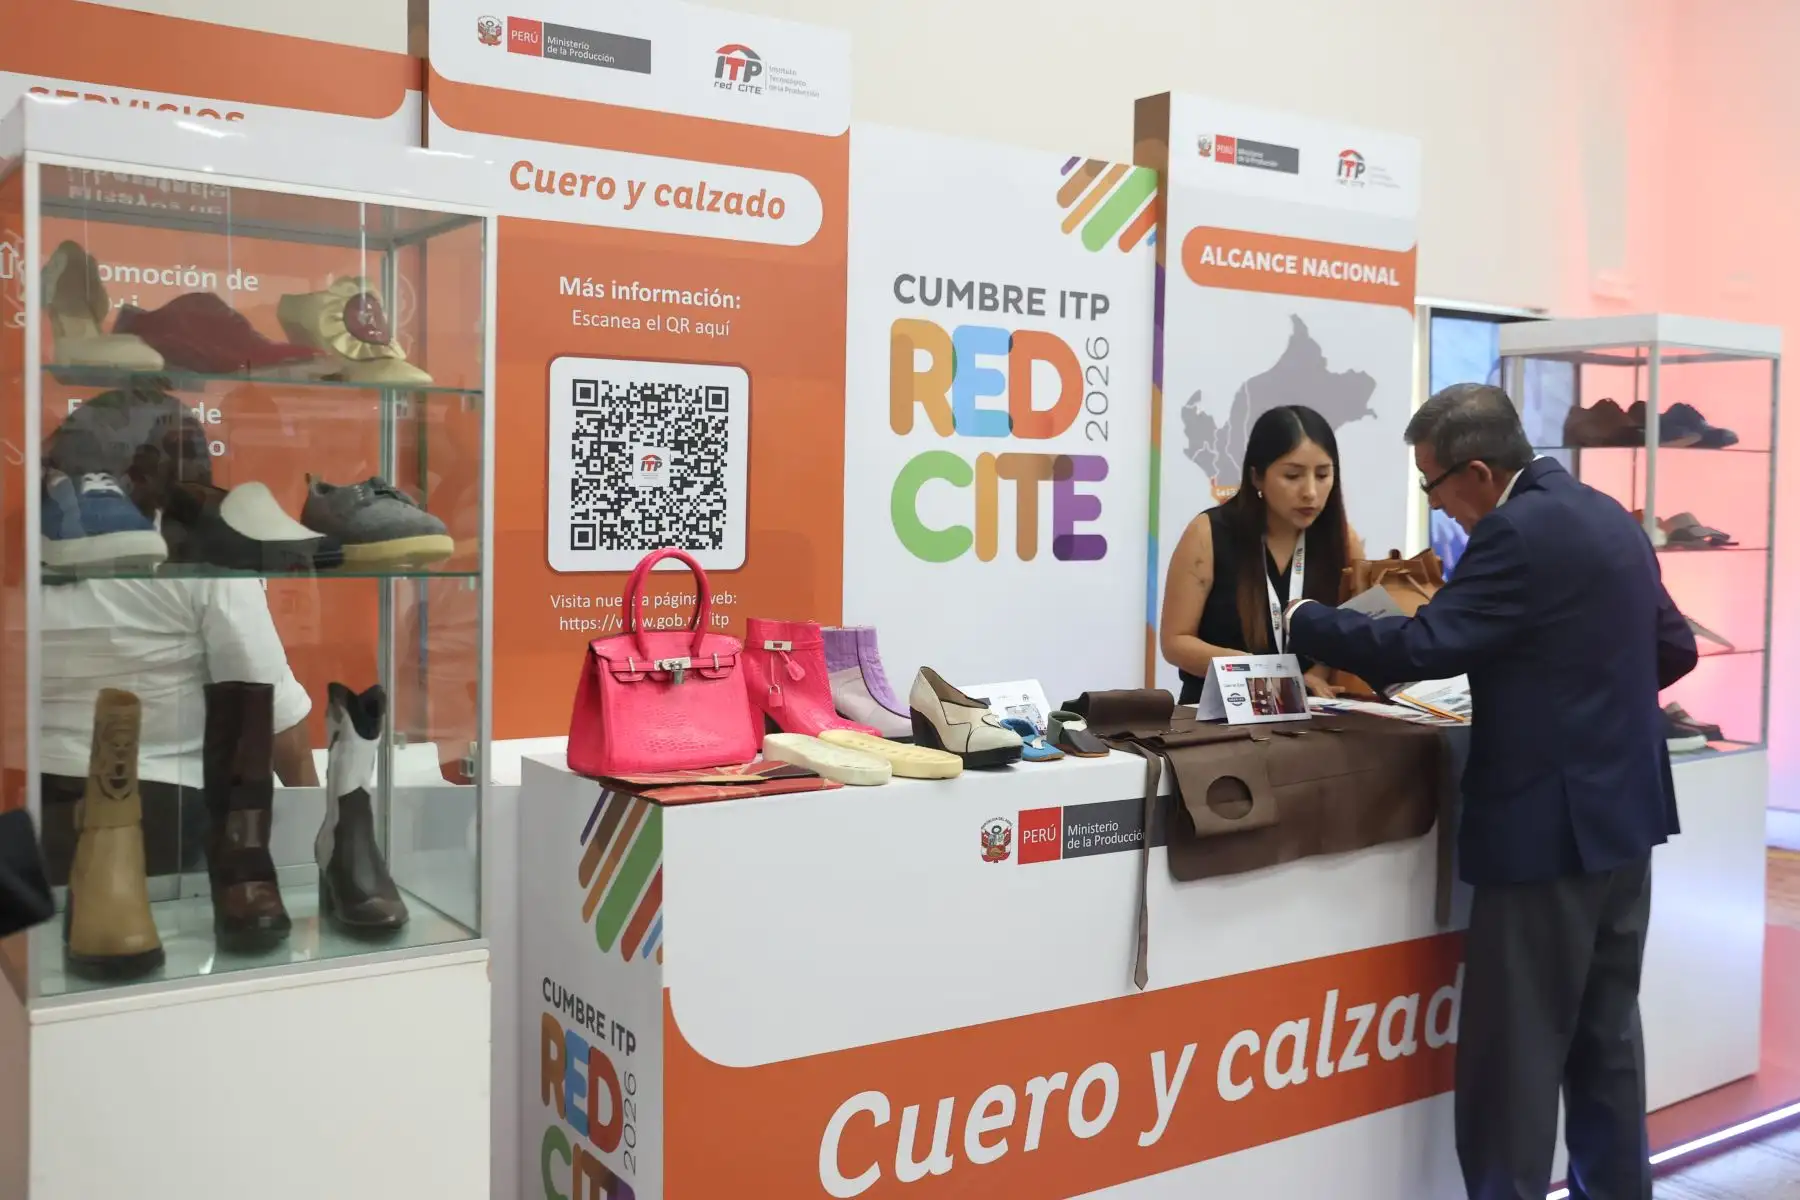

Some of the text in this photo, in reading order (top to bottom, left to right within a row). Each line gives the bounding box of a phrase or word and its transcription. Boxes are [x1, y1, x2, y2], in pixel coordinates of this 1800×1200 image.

[511, 29, 539, 44] PERÚ
[547, 36, 590, 51] Ministerio
[547, 45, 615, 64] de la Producción
[715, 55, 762, 83] ITP
[714, 80, 762, 95] red CITE
[1338, 159, 1365, 179] ITP
[509, 160, 785, 220] Cuero y calzado
[98, 264, 259, 291] omoción de
[1200, 245, 1400, 286] ALCANCE NACIONAL
[559, 275, 741, 309] Más información:
[893, 273, 1110, 321] CUMBRE ITP
[572, 309, 730, 338] Escanea el QR aquí
[889, 317, 1084, 440] RED
[1085, 335, 1110, 442] 2026
[641, 460, 663, 472] ITP
[890, 450, 1109, 563] CITE
[550, 594, 591, 609] Visita
[595, 595, 649, 608] nuea
[1023, 824, 1057, 845] PERÚ
[1067, 820, 1119, 837] Ministerio
[1067, 837, 1081, 850] de
[1082, 837, 1092, 848] la
[542, 976, 636, 1056] CUMBRE ITP
[541, 1011, 624, 1153] RED
[818, 961, 1466, 1198] Cuero y calzad
[624, 1070, 637, 1177] 2026
